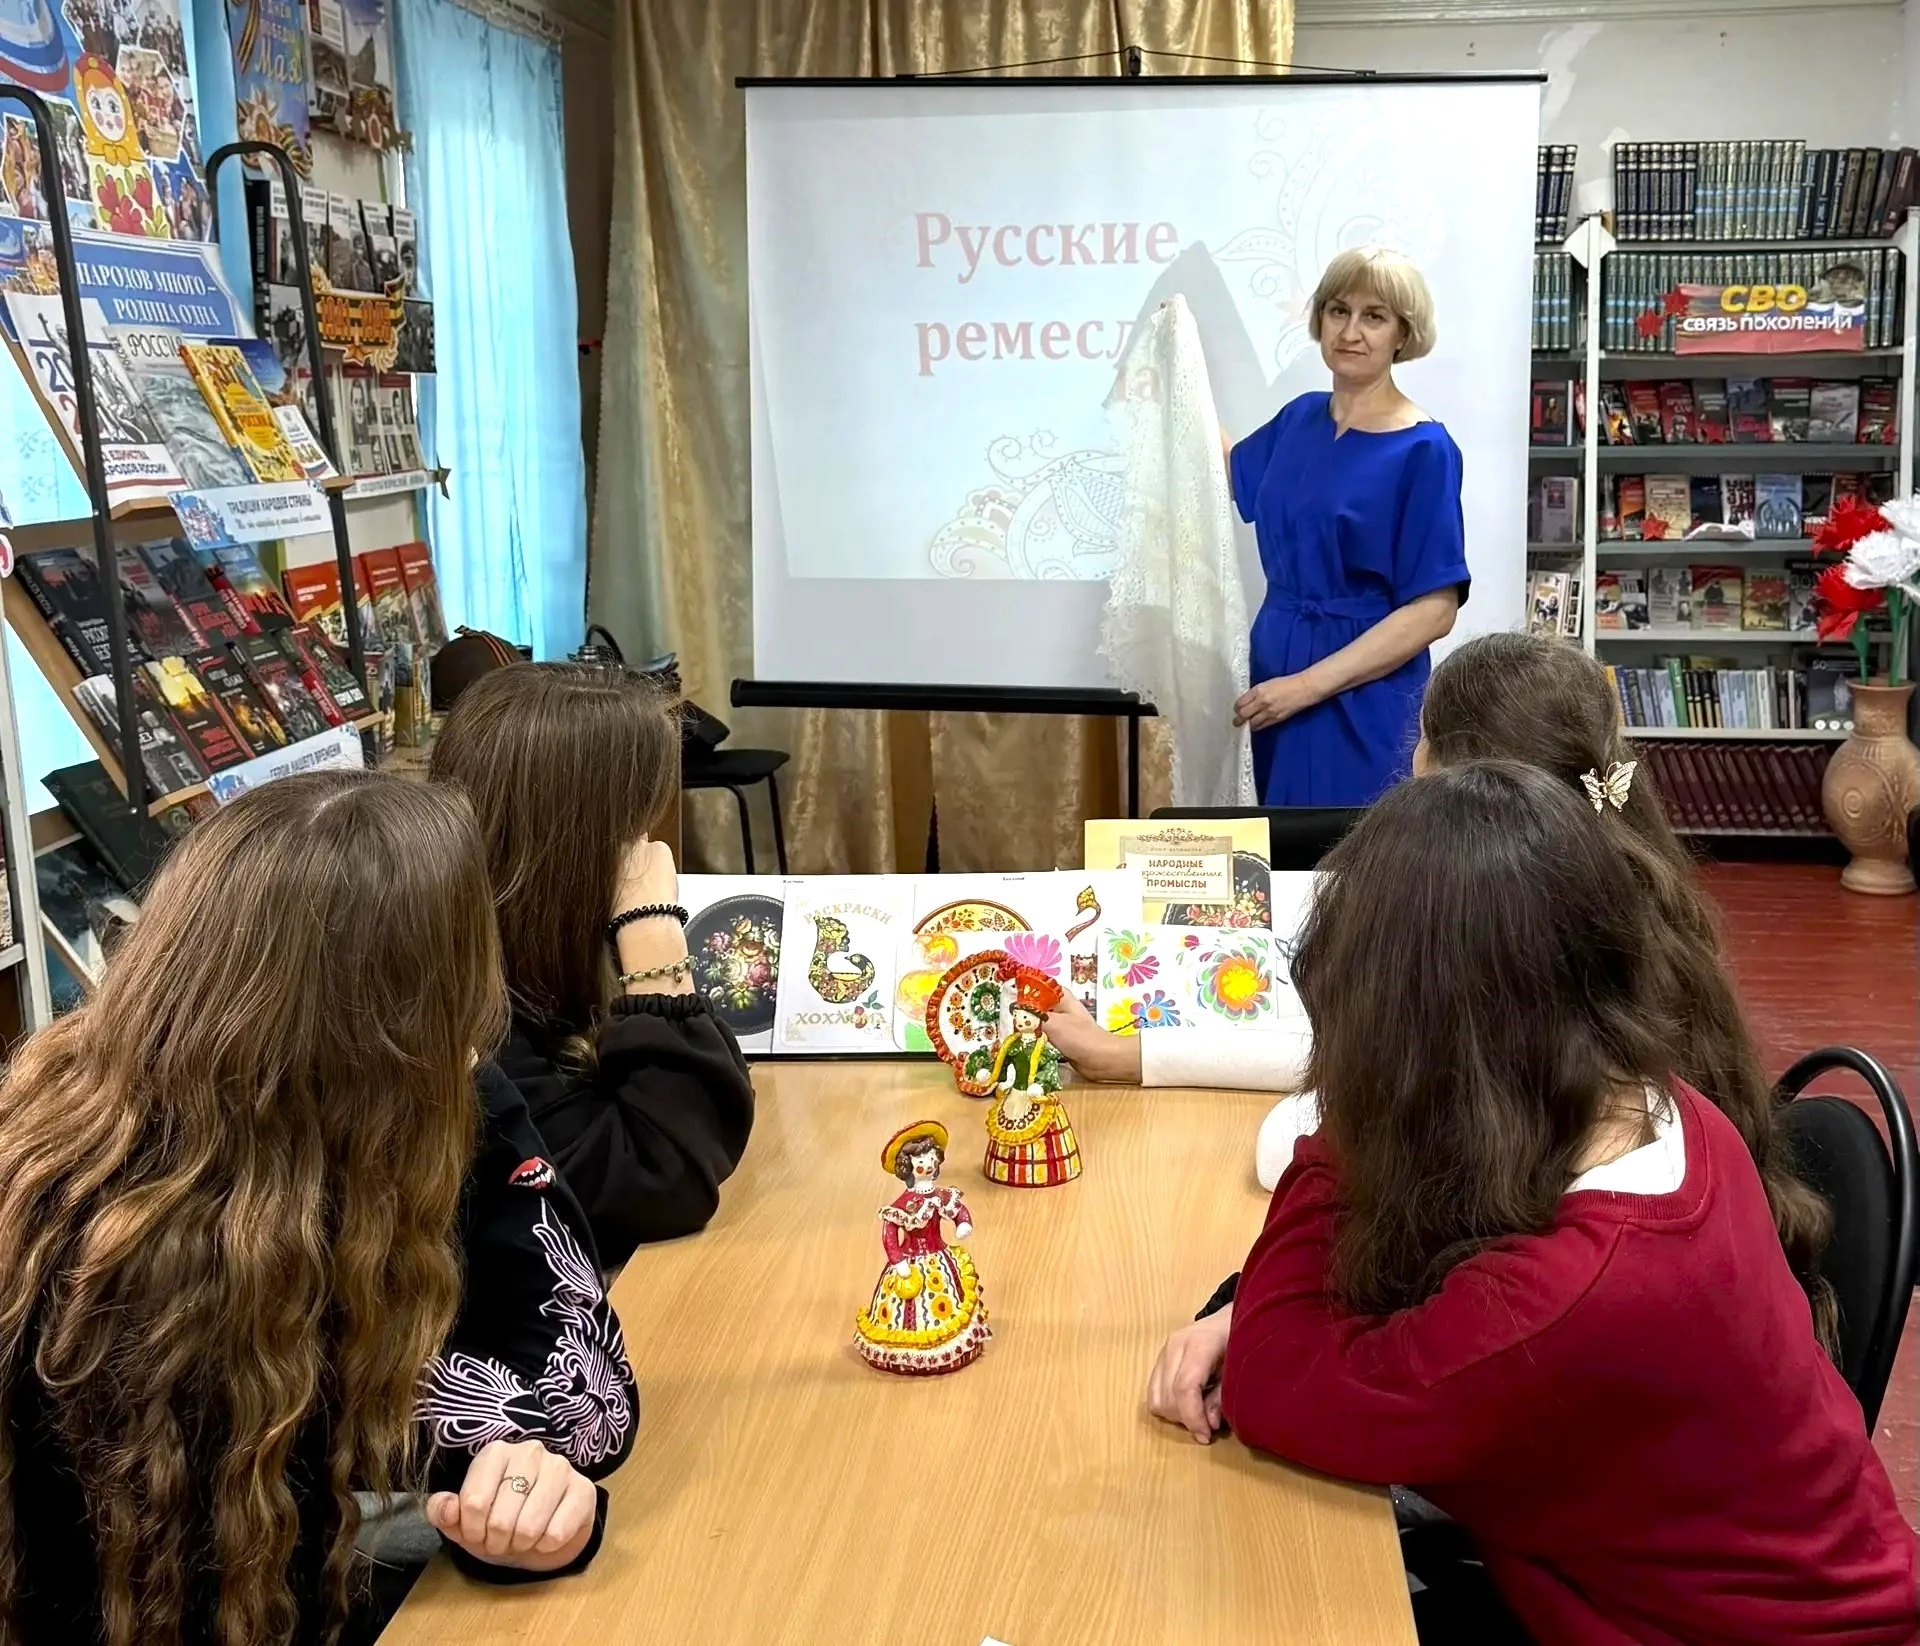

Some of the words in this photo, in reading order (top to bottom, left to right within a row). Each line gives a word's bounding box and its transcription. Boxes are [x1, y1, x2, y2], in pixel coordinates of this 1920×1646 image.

[914, 212, 1179, 284] Русские
[75, 262, 153, 291] НАРОДОВ
[154, 270, 206, 296] МНОГО
[1721, 284, 1808, 313] СВО
[113, 298, 181, 324] РОДИНА
[181, 304, 222, 326] ОДНА
[104, 463, 139, 475] АРОДОВ
[1149, 859, 1204, 869] НАРОДНЫЕ
[1142, 868, 1223, 880] дожественные
[1146, 879, 1207, 889] ПРОМЫСЛЫ
[794, 1010, 887, 1025] ХОХЛМА
